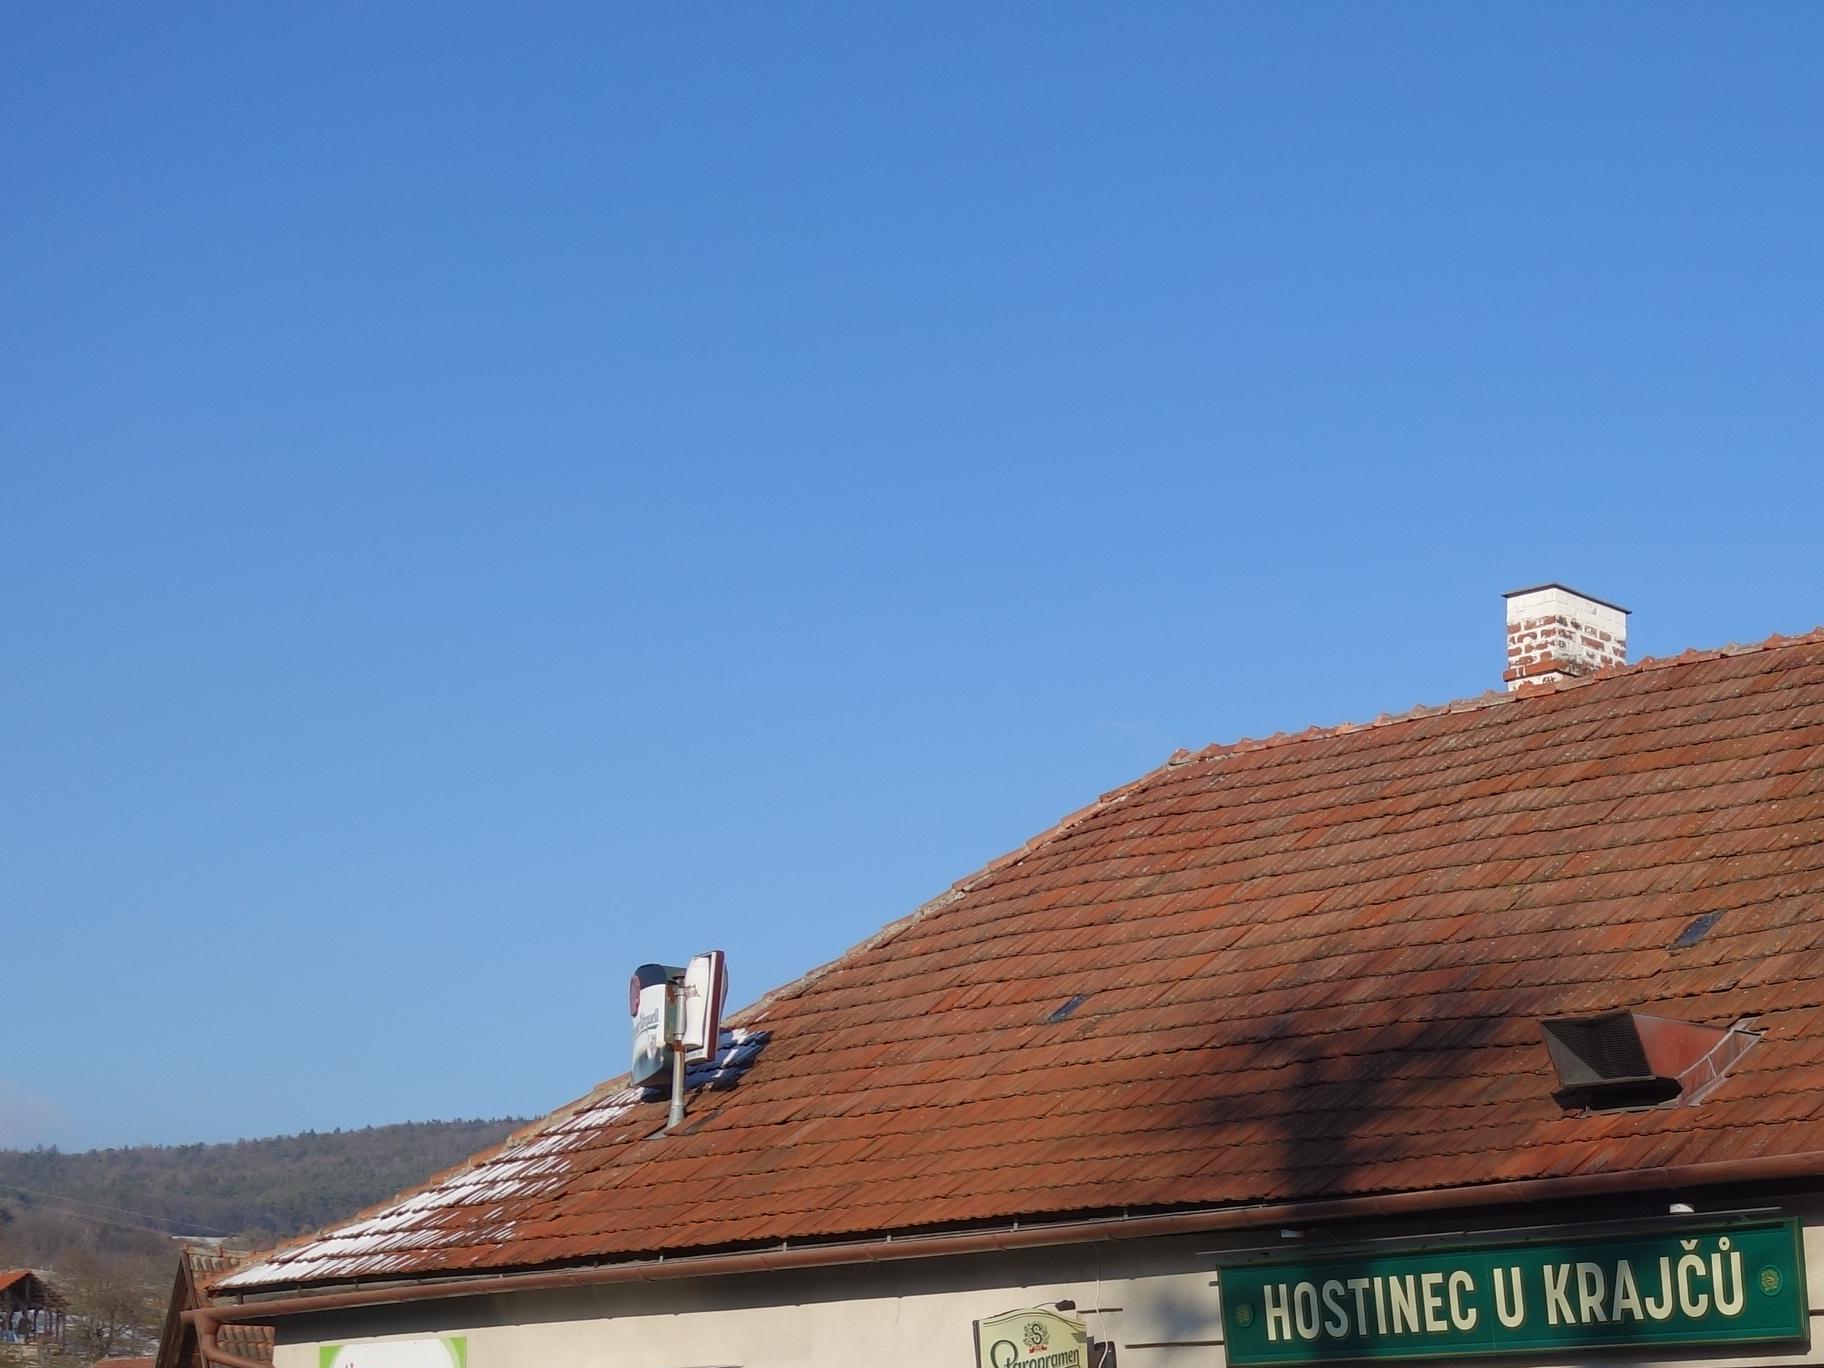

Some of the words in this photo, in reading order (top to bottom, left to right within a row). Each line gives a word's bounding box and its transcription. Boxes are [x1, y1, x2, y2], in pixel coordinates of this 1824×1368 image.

[1263, 1270, 1478, 1341] HOSTINEC
[1493, 1266, 1525, 1328] U
[1543, 1236, 1745, 1326] KRAJČŮ
